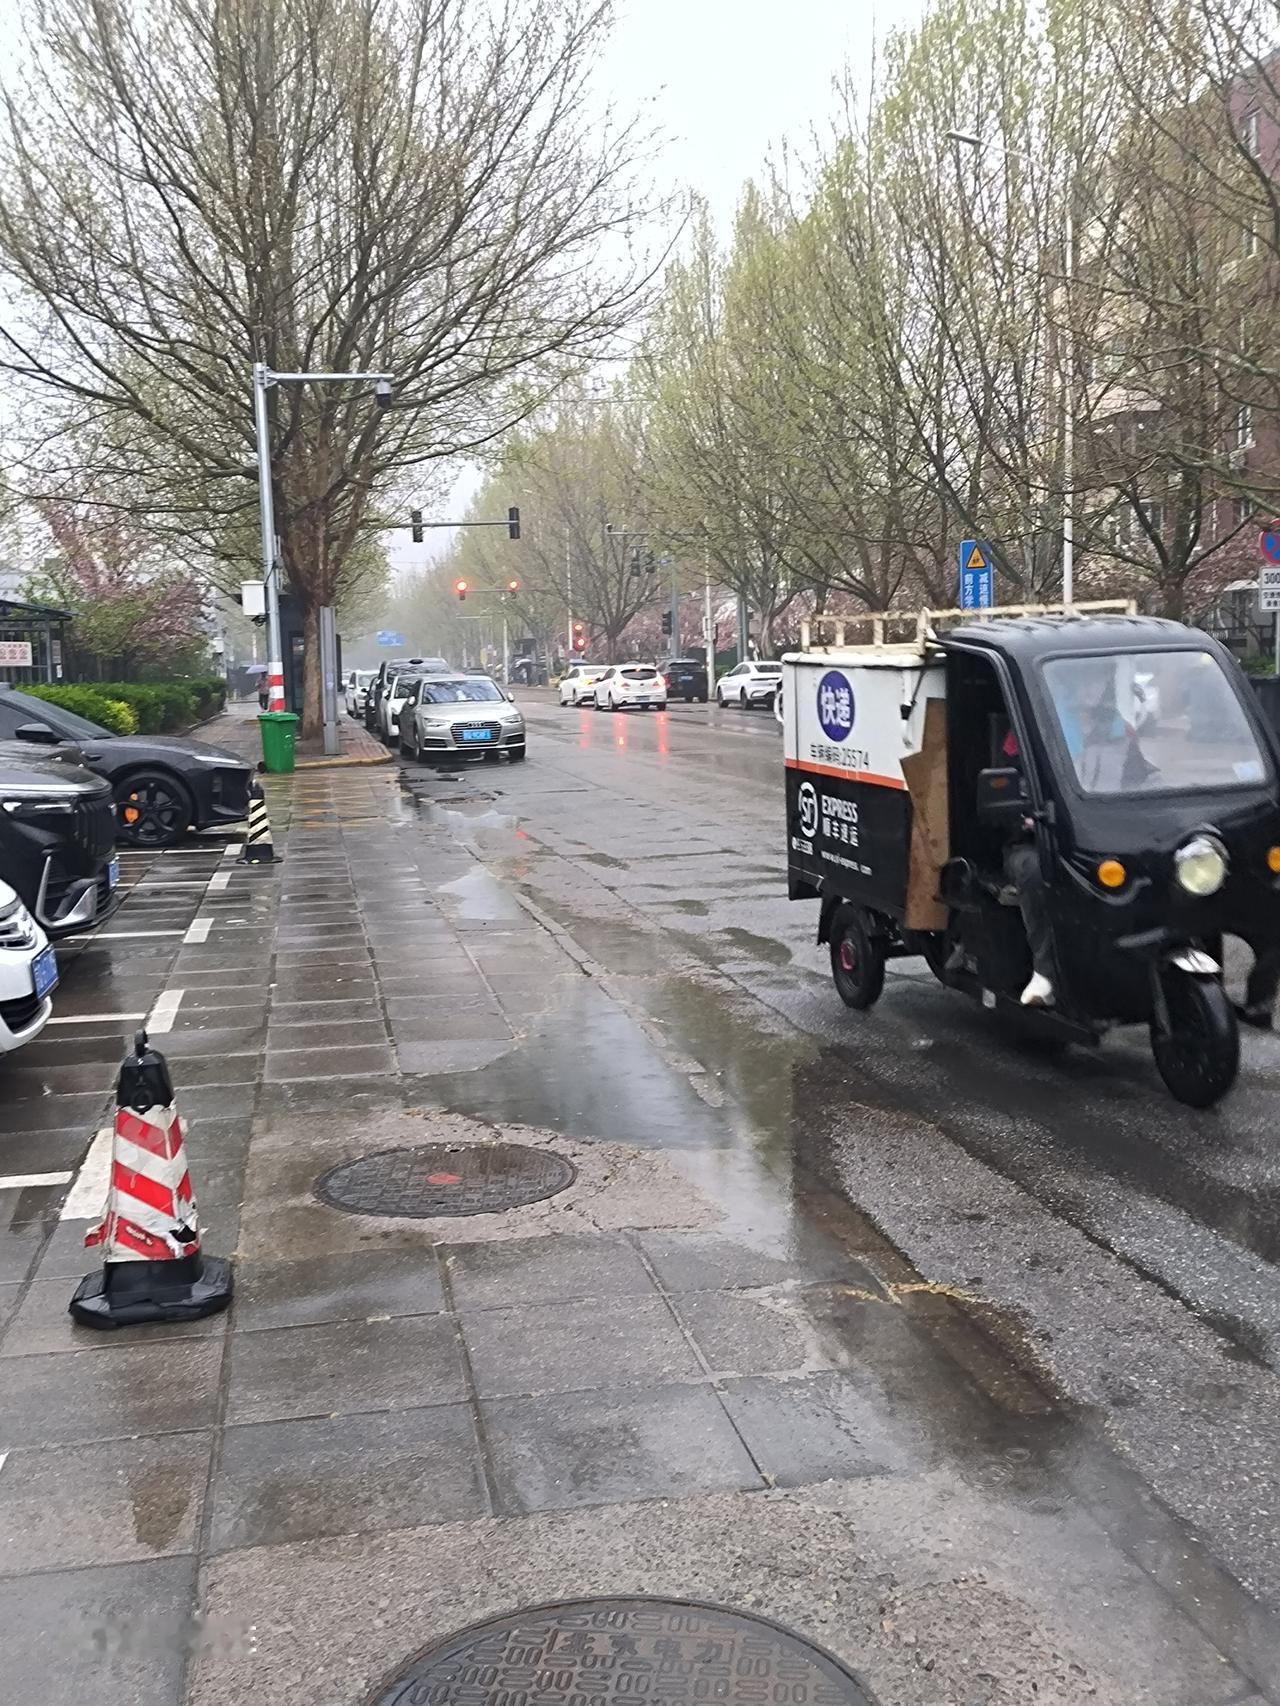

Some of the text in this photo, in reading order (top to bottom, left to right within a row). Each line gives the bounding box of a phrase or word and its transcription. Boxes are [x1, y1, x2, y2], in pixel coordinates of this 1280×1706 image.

[821, 685, 851, 728] 快递
[821, 794, 858, 823] EXPRESS
[822, 816, 859, 847] 顺丰速运
[558, 1631, 725, 1663] 北京电力
